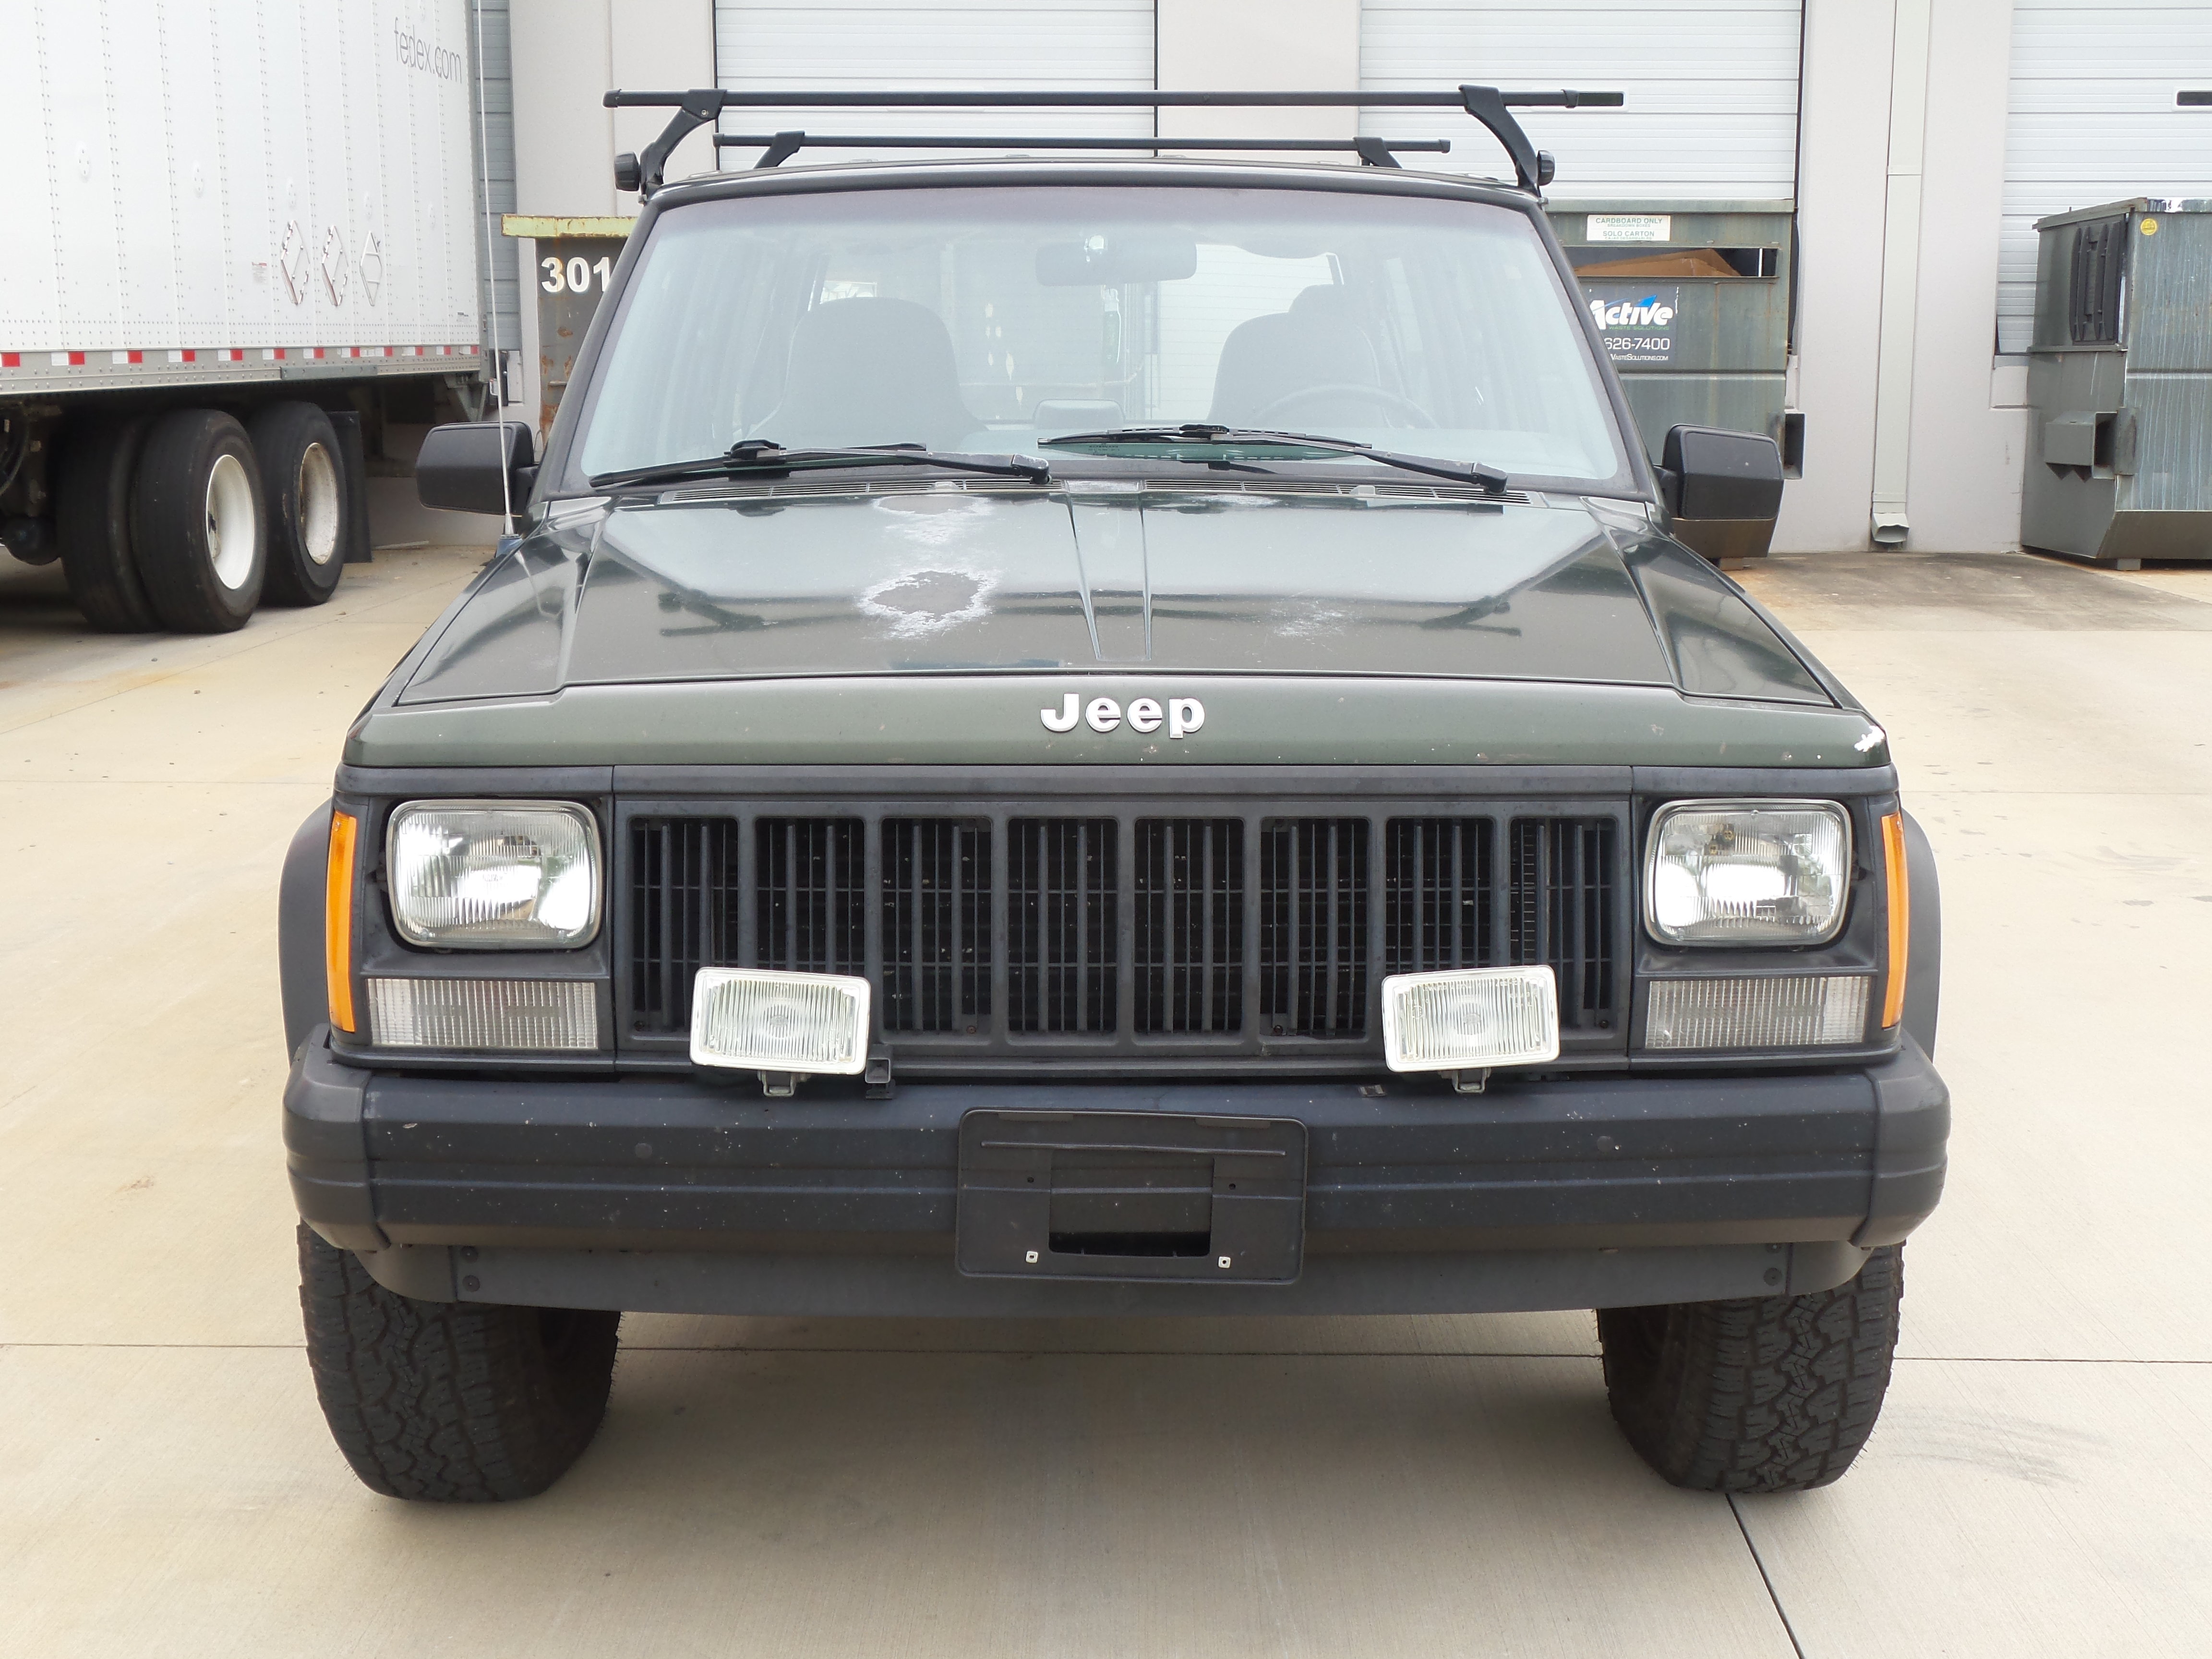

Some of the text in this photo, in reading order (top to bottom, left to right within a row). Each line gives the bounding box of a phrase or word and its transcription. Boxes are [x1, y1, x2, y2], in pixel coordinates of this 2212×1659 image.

[394, 16, 462, 84] fedex.com
[541, 256, 610, 293] 301
[1040, 693, 1205, 739] Jeep
